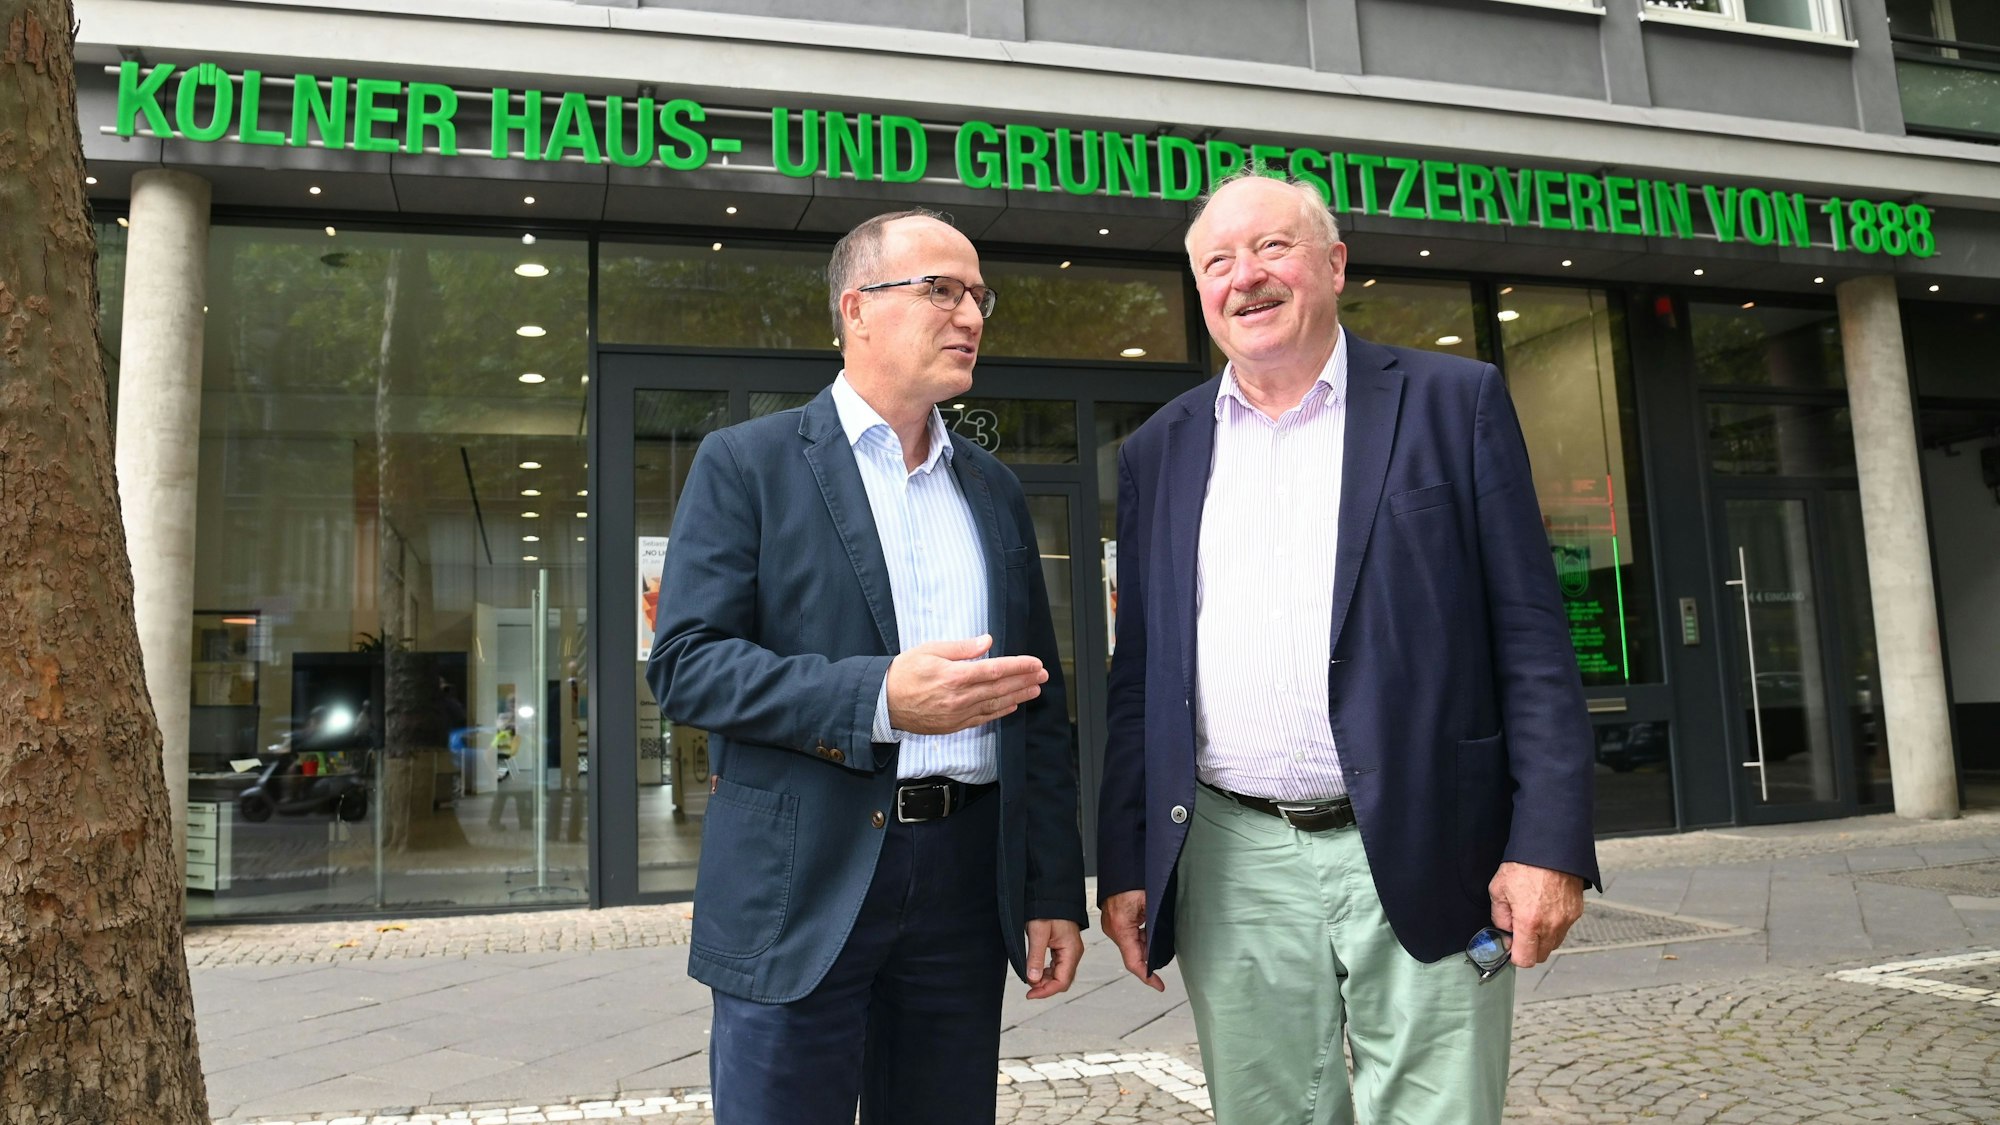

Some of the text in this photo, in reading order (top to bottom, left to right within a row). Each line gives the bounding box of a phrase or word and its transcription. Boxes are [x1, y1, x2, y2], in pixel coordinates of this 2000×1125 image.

[115, 60, 1936, 258] KÖLNER HAUS- UND GRUNDBESITZERVEREIN VON 1888
